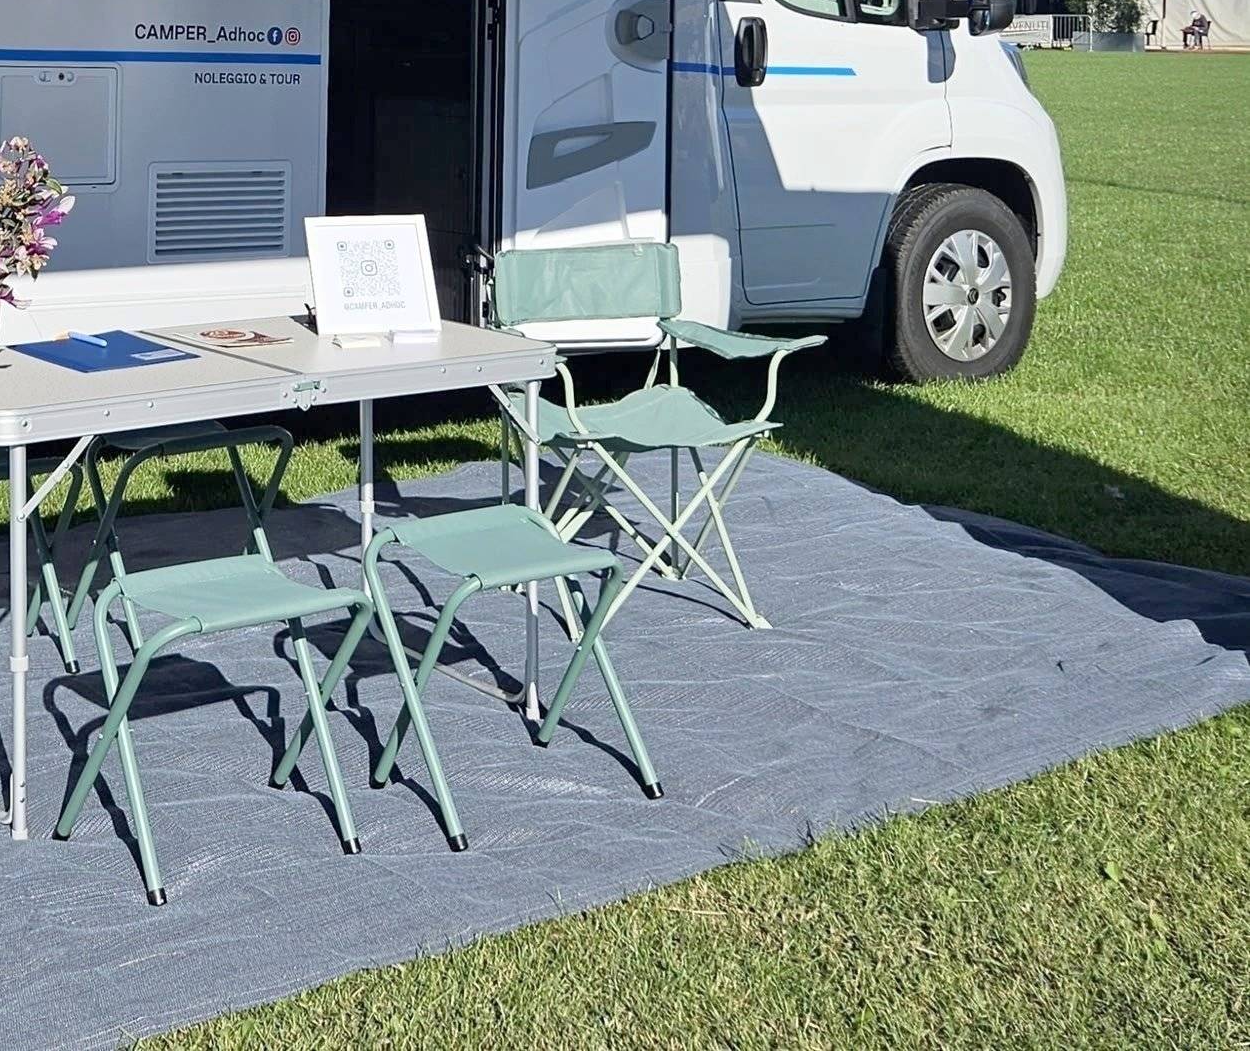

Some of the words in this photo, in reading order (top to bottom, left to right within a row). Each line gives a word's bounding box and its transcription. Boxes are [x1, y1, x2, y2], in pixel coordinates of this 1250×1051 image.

[134, 23, 266, 44] CAMPER_Adhoc
[194, 72, 257, 85] NOLEGGIO
[259, 73, 267, 85] &
[269, 73, 301, 85] TOUR
